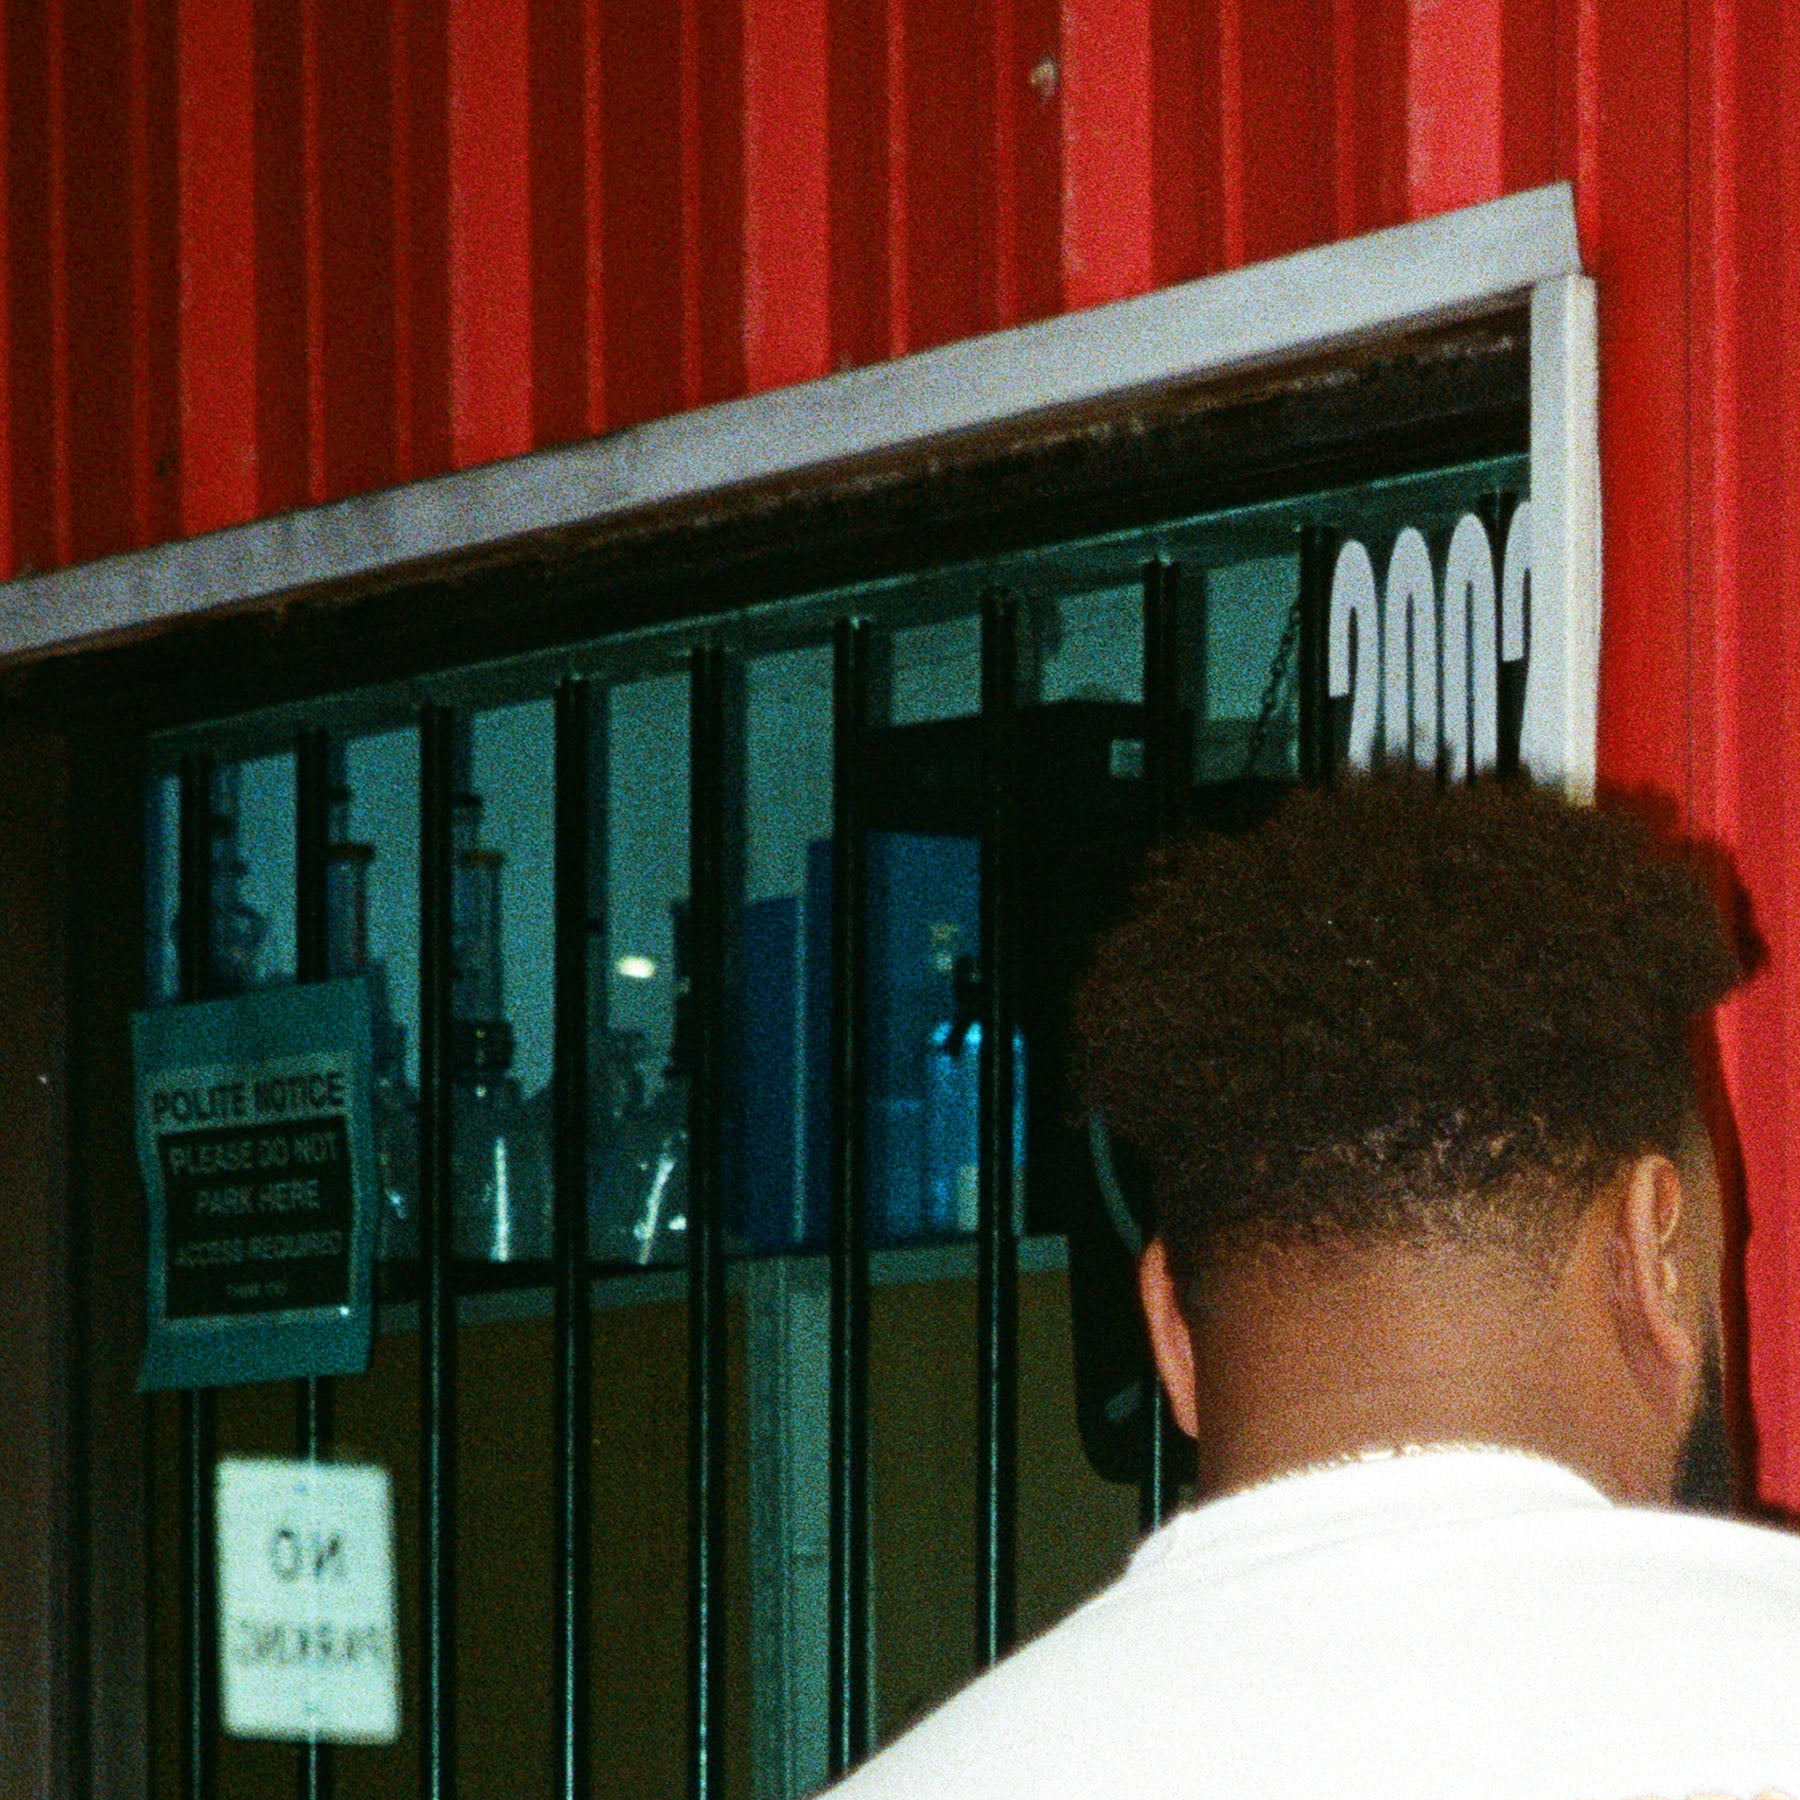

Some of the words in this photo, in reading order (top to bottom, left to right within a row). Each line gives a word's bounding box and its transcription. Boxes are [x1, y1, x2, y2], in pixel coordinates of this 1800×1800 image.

[152, 1081, 245, 1124] POLITE
[254, 1071, 345, 1113] NOTICE
[169, 1140, 253, 1174] PLEASE
[292, 1132, 338, 1163] NOT
